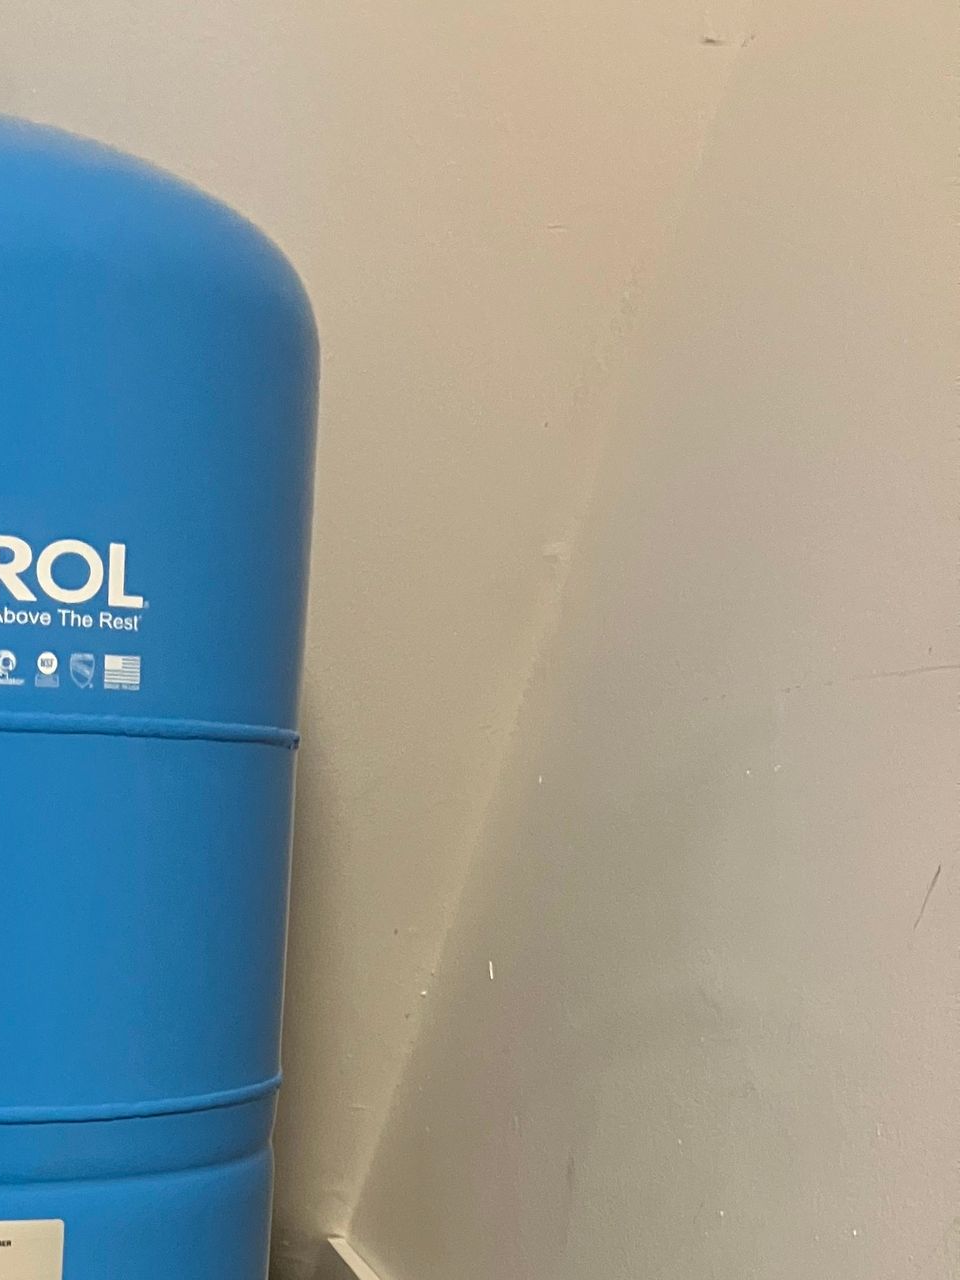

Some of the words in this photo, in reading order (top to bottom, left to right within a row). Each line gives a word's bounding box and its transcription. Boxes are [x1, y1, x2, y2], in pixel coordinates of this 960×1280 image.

[58, 608, 93, 628] The
[100, 612, 139, 631] Rest
[40, 658, 54, 667] NSF
